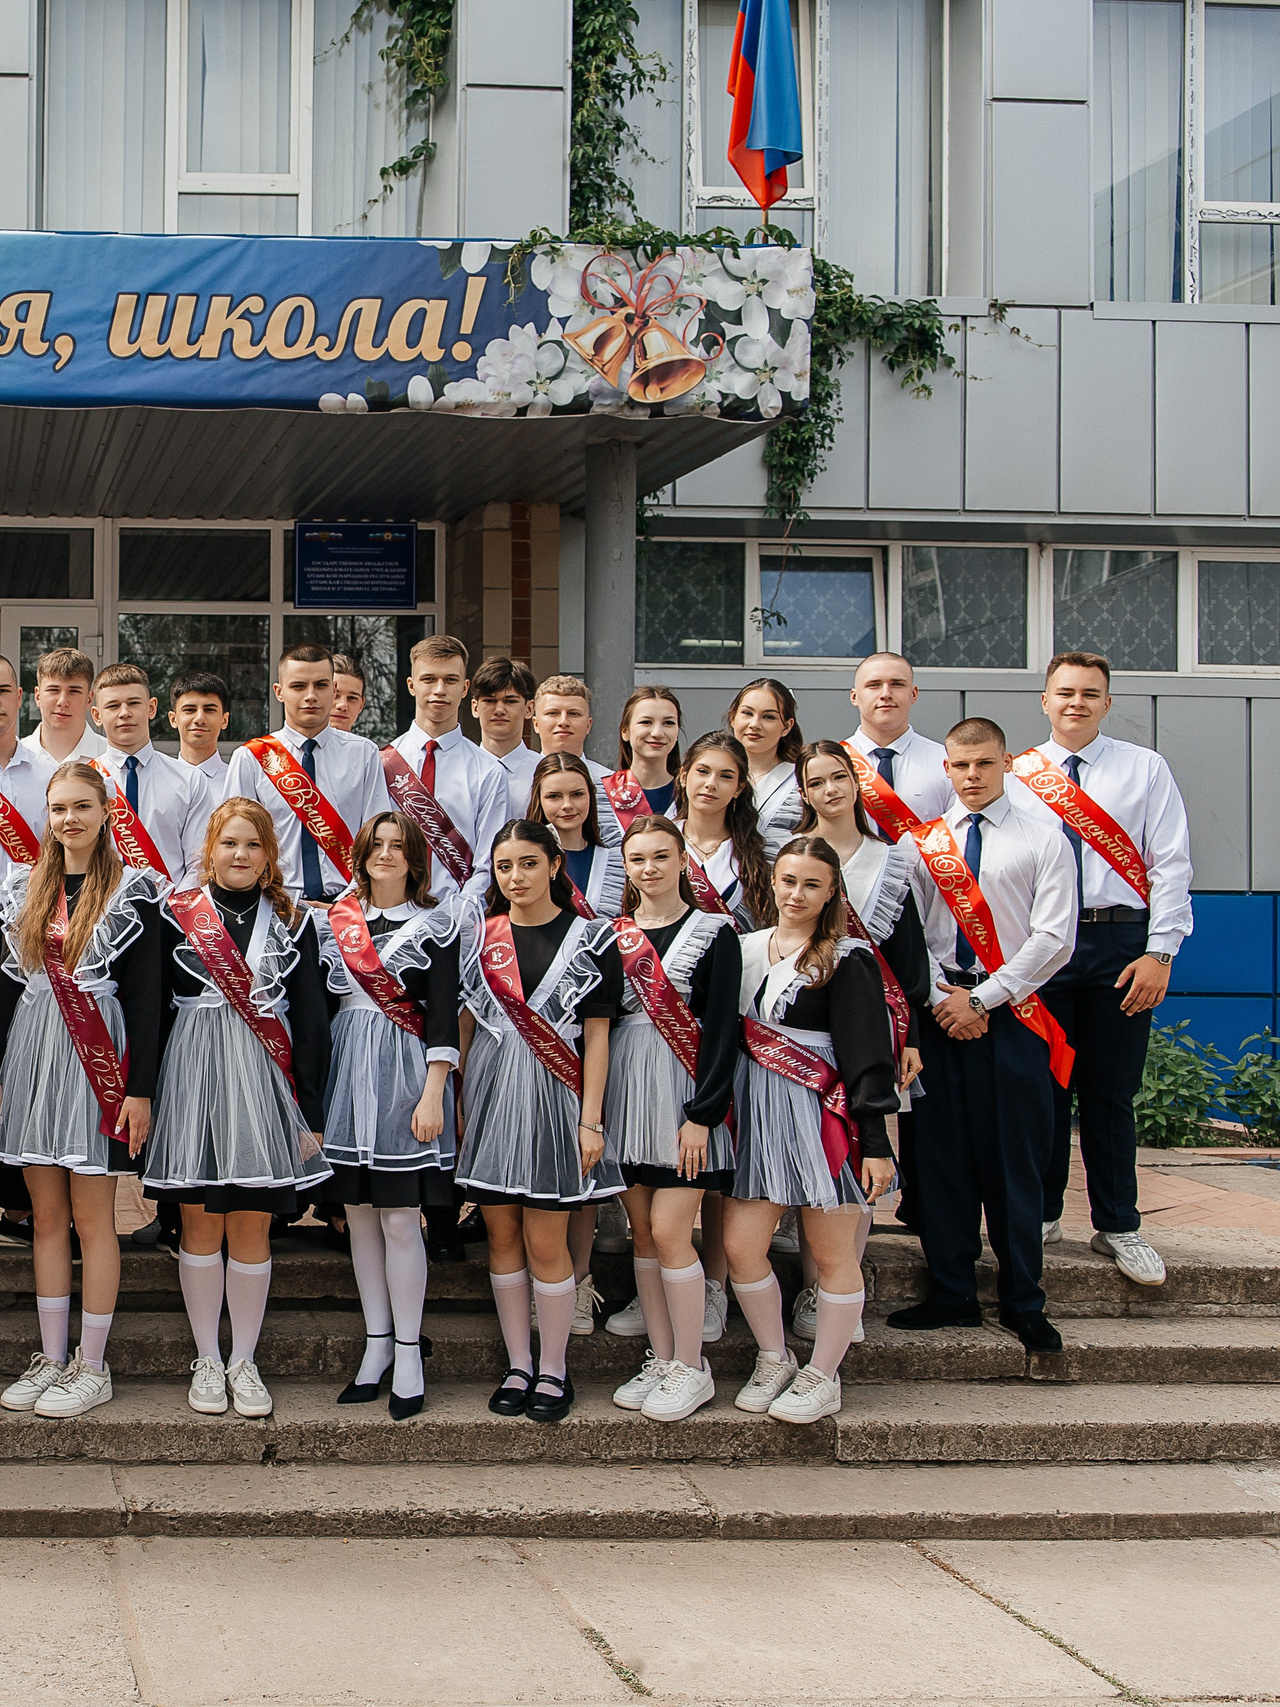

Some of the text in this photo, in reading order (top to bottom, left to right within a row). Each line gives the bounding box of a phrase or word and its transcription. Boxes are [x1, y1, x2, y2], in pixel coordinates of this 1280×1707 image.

[107, 275, 488, 362] школа!
[1029, 771, 1134, 866] Выпускник
[82, 1045, 124, 1103] 2026
